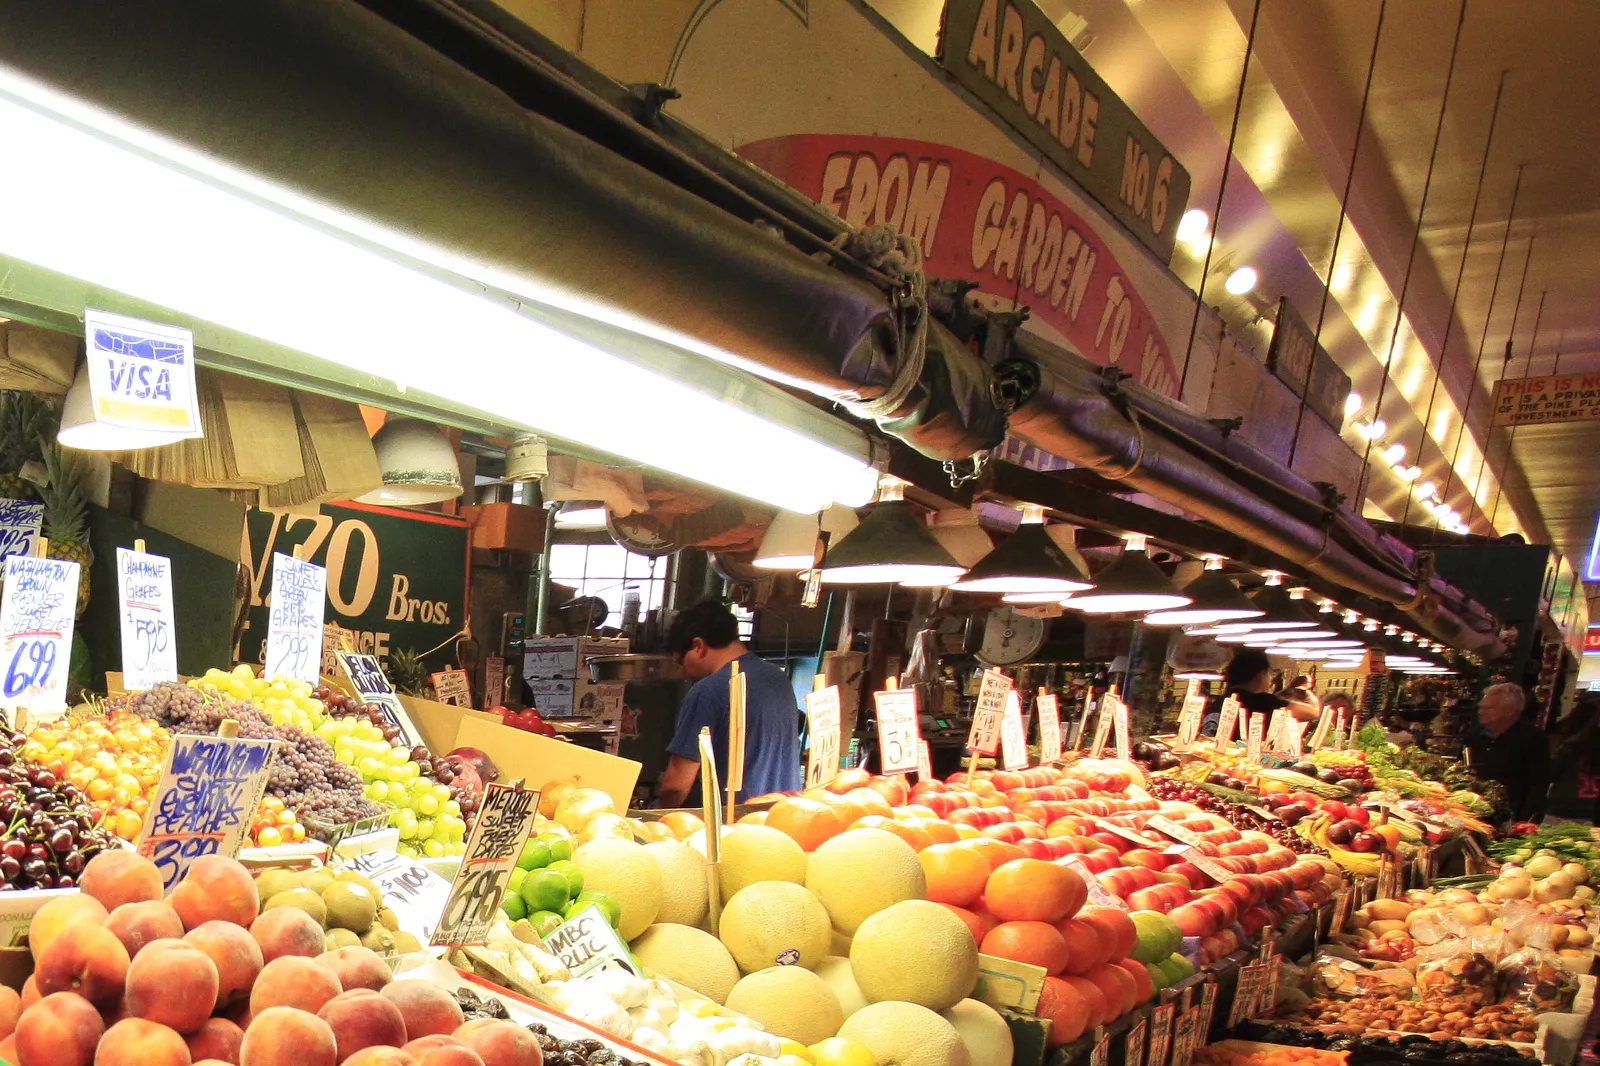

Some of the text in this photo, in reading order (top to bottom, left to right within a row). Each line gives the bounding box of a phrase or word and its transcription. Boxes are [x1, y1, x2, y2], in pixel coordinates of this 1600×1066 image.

[967, 0, 1099, 168] ARCADE
[1151, 155, 1172, 236] 6
[972, 177, 1096, 322] GARDEN
[1095, 276, 1131, 364] TO
[108, 358, 173, 402] VISA
[1504, 380, 1544, 394] THIS
[1554, 377, 1572, 390] IS
[8, 559, 72, 584] WASHINGTON
[125, 577, 162, 600] GRAPES
[386, 574, 450, 625] Bros.
[151, 807, 244, 836] PEACHES
[471, 842, 519, 859] DATES
